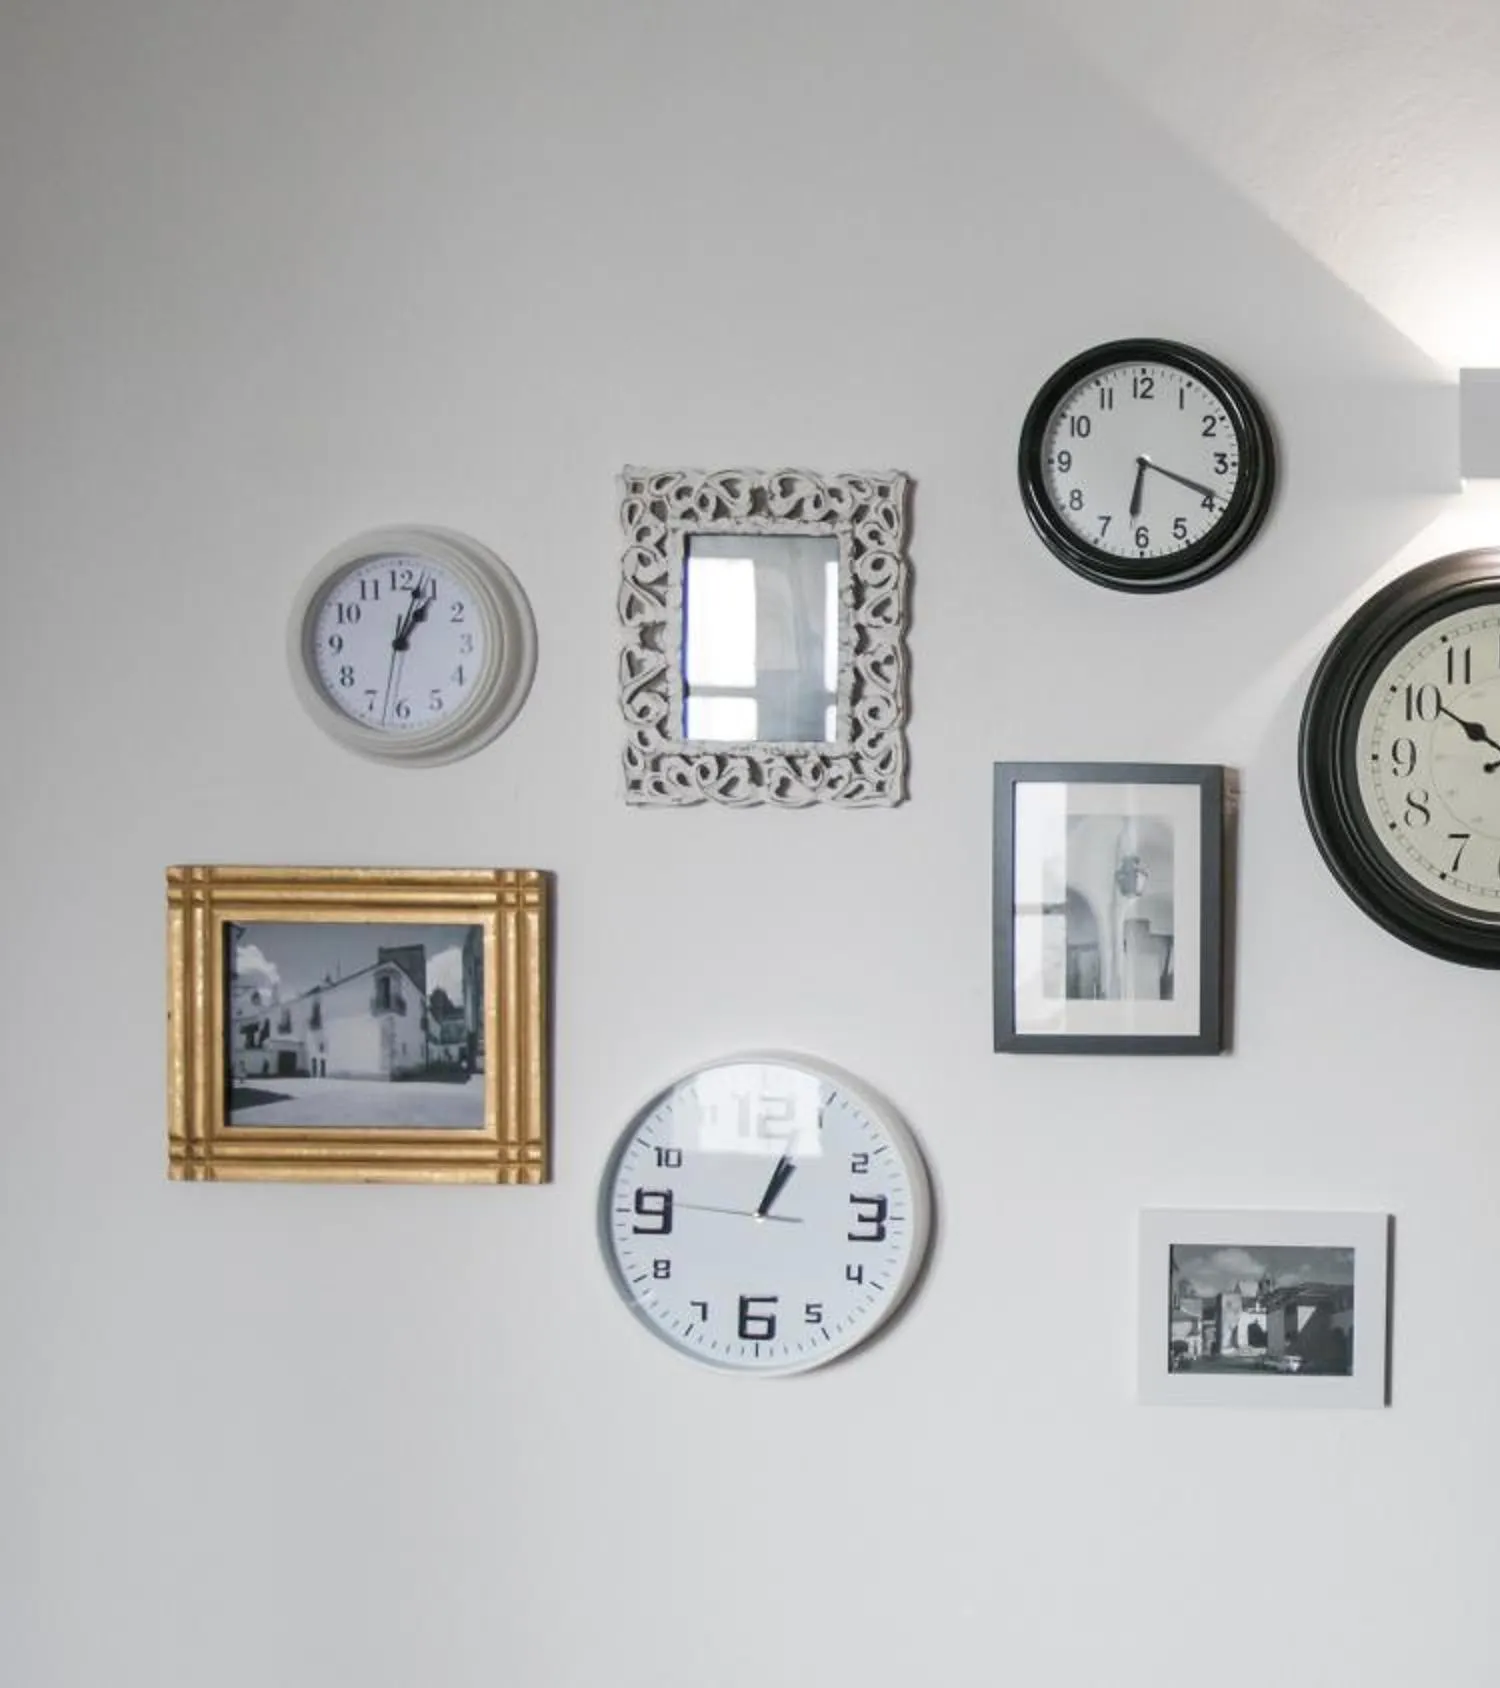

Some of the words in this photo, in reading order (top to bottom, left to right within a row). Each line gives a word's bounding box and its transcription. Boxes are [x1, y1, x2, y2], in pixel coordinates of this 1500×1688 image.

[1100, 387, 1113, 410] 11
[1133, 377, 1154, 399] 12
[1179, 388, 1185, 410] 1
[1070, 415, 1091, 438] 10
[1201, 415, 1217, 437] 2
[1057, 450, 1072, 473] 9
[1214, 453, 1229, 475] 3
[1069, 489, 1084, 511] 8
[1200, 494, 1215, 513] 4
[1098, 516, 1112, 537] 7
[1135, 526, 1149, 549] 6
[1173, 517, 1187, 540] 5
[359, 579, 380, 601] 11
[390, 569, 414, 591] 12
[430, 579, 437, 600] 1
[336, 602, 361, 624] 10
[450, 602, 465, 623] 2
[329, 634, 344, 656] 9
[460, 634, 473, 654] 3
[340, 665, 355, 687] 8
[452, 665, 466, 686] 4
[1447, 646, 1471, 685] 11
[365, 689, 378, 711] 7
[396, 697, 410, 718] 6
[429, 689, 443, 711] 5
[1405, 683, 1442, 722] 10
[1392, 738, 1417, 778] 9
[1404, 789, 1431, 827] 8
[1447, 833, 1471, 873] 7
[731, 1090, 795, 1138] 12
[654, 1146, 683, 1168] 10
[851, 1152, 869, 1174] 2
[633, 1186, 673, 1235] 9
[847, 1193, 888, 1243] 3
[652, 1258, 672, 1280] 8
[845, 1264, 863, 1285] 4
[690, 1300, 709, 1322] 7
[737, 1295, 779, 1341] 6
[805, 1303, 823, 1324] 5
